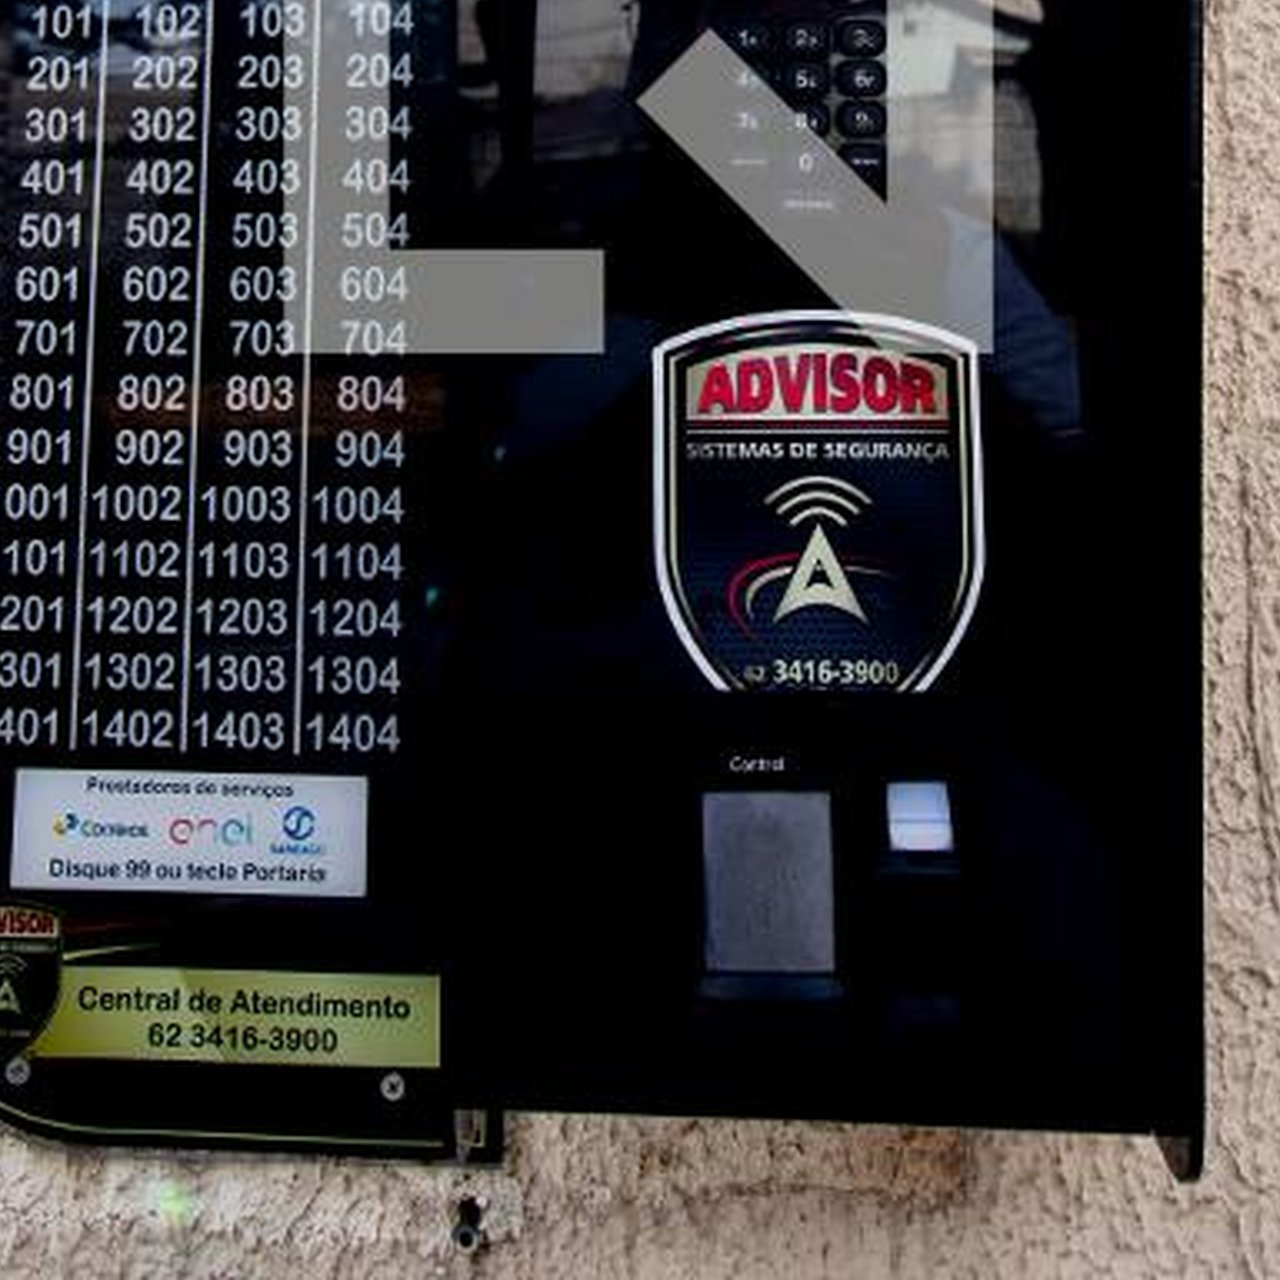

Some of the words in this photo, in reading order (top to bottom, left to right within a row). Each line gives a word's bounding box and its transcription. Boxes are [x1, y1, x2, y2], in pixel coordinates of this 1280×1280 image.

[31, 4, 91, 38] 101
[135, 4, 200, 38] 102
[240, 4, 305, 38] 103
[350, 3, 415, 37] 104
[27, 56, 90, 90] 201
[133, 56, 197, 89] 202
[238, 56, 303, 89] 203
[346, 55, 414, 88] 204
[25, 108, 89, 142] 301
[129, 108, 194, 141] 302
[235, 107, 301, 141] 303
[345, 107, 414, 141] 304
[21, 160, 84, 195] 401
[126, 160, 193, 194] 402
[234, 160, 300, 194] 403
[343, 159, 410, 193] 404
[20, 214, 82, 248] 501
[125, 214, 191, 248] 502
[232, 213, 298, 248] 503
[343, 213, 409, 247] 504
[16, 268, 79, 301] 601
[123, 268, 190, 301] 602
[230, 268, 297, 301] 603
[340, 267, 408, 301] 604
[16, 322, 75, 355] 701
[123, 321, 188, 355] 702
[230, 321, 296, 355] 703
[343, 321, 408, 355] 704
[10, 376, 74, 409] 801
[118, 376, 185, 410] 802
[226, 377, 294, 411] 803
[338, 377, 406, 411] 804
[697, 352, 937, 415] ADVISOR
[7, 430, 73, 464] 901
[116, 430, 184, 465] 902
[224, 430, 292, 466] 903
[335, 431, 404, 467] 904
[685, 442, 783, 459] SISTEMAS
[791, 443, 817, 459] DE
[824, 442, 950, 463] SEGURANÇA
[92, 486, 181, 520] 1002
[201, 487, 291, 521] 1003
[313, 487, 404, 523] 1004
[89, 541, 179, 576] 1102
[199, 543, 289, 578] 1103
[311, 544, 404, 580] 1104
[87, 597, 178, 633] 1202
[196, 599, 287, 634] 1203
[310, 600, 401, 636] 1204
[84, 654, 175, 690] 1302
[194, 655, 286, 692] 1303
[308, 657, 400, 694] 1304
[773, 659, 899, 685] 3416-3900
[82, 710, 172, 746] 1402
[193, 712, 284, 748] 1403
[306, 715, 400, 751] 1404
[87, 777, 190, 795] Prestadores
[195, 779, 216, 794] de
[50, 859, 120, 881] Disque
[126, 860, 151, 879] 99
[156, 866, 181, 880] ou
[186, 862, 237, 881] tecle
[243, 863, 326, 882] Portaria
[78, 985, 178, 1013] Central
[190, 986, 221, 1014] de
[230, 986, 410, 1021] Atendimento
[148, 1023, 181, 1049] 62
[190, 1025, 338, 1053] 3416-3900
